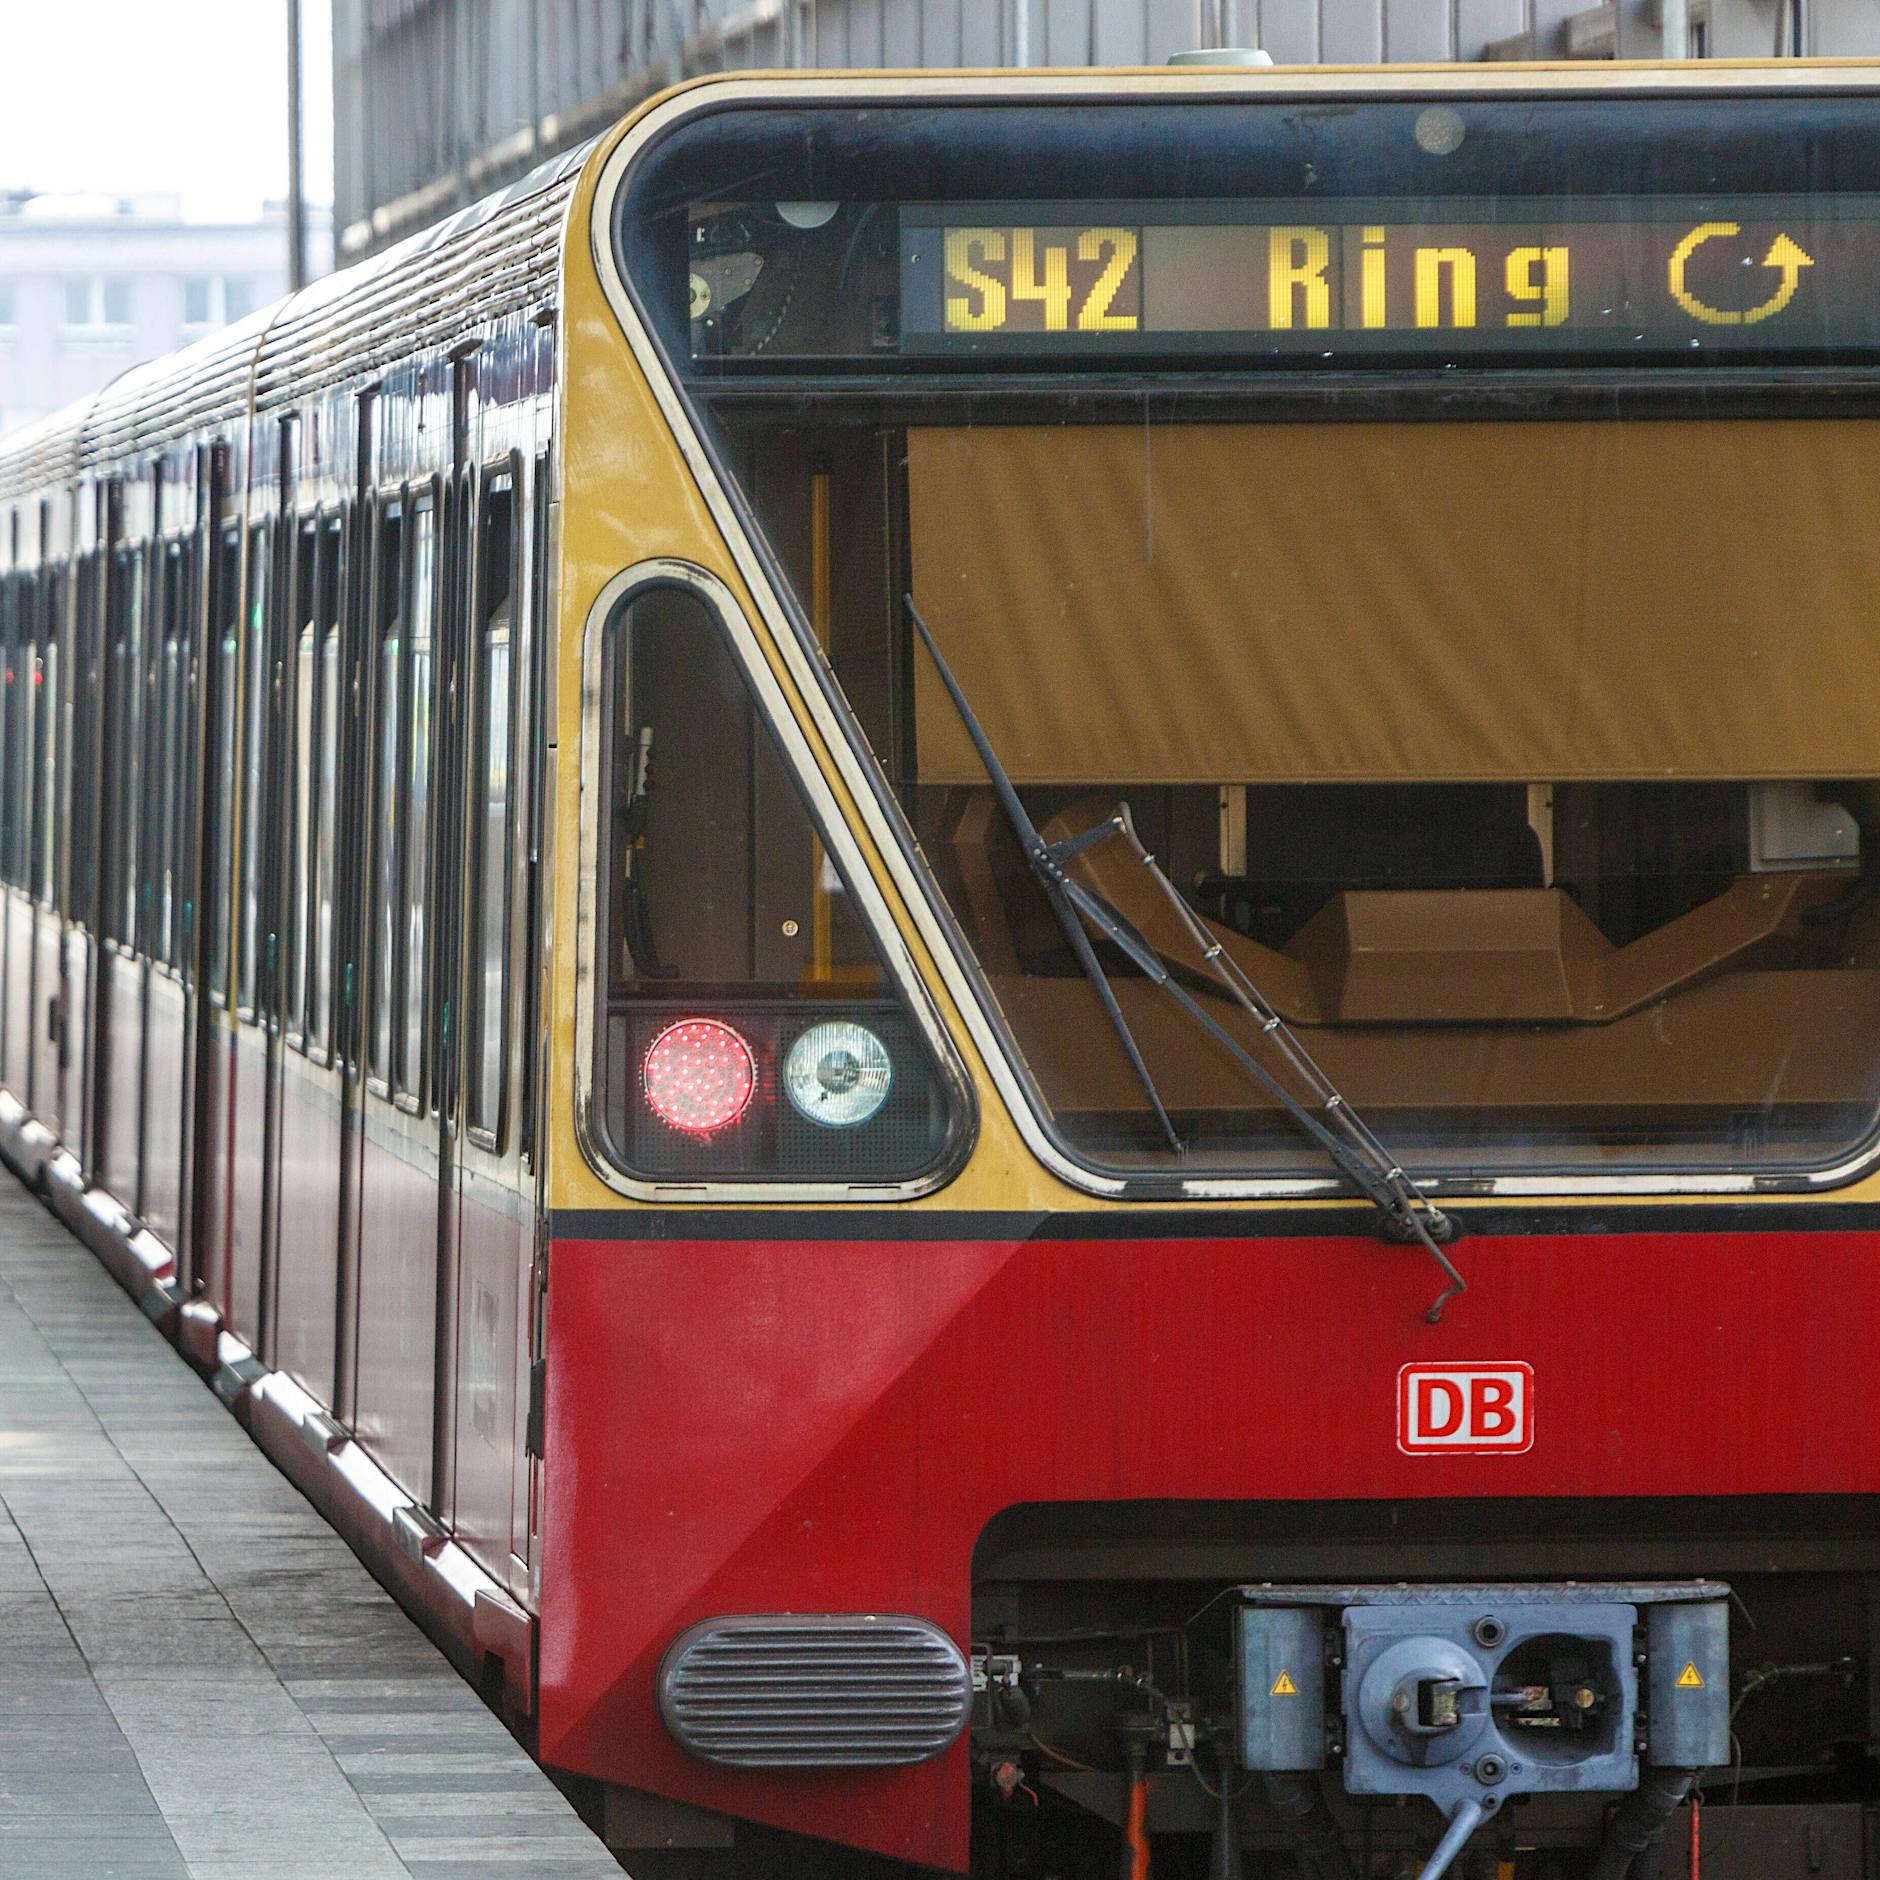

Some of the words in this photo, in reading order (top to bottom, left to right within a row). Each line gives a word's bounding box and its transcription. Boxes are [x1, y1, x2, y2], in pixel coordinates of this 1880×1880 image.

[947, 227, 1138, 331] S42
[1269, 225, 1570, 329] Ring
[1417, 1378, 1517, 1438] DB
